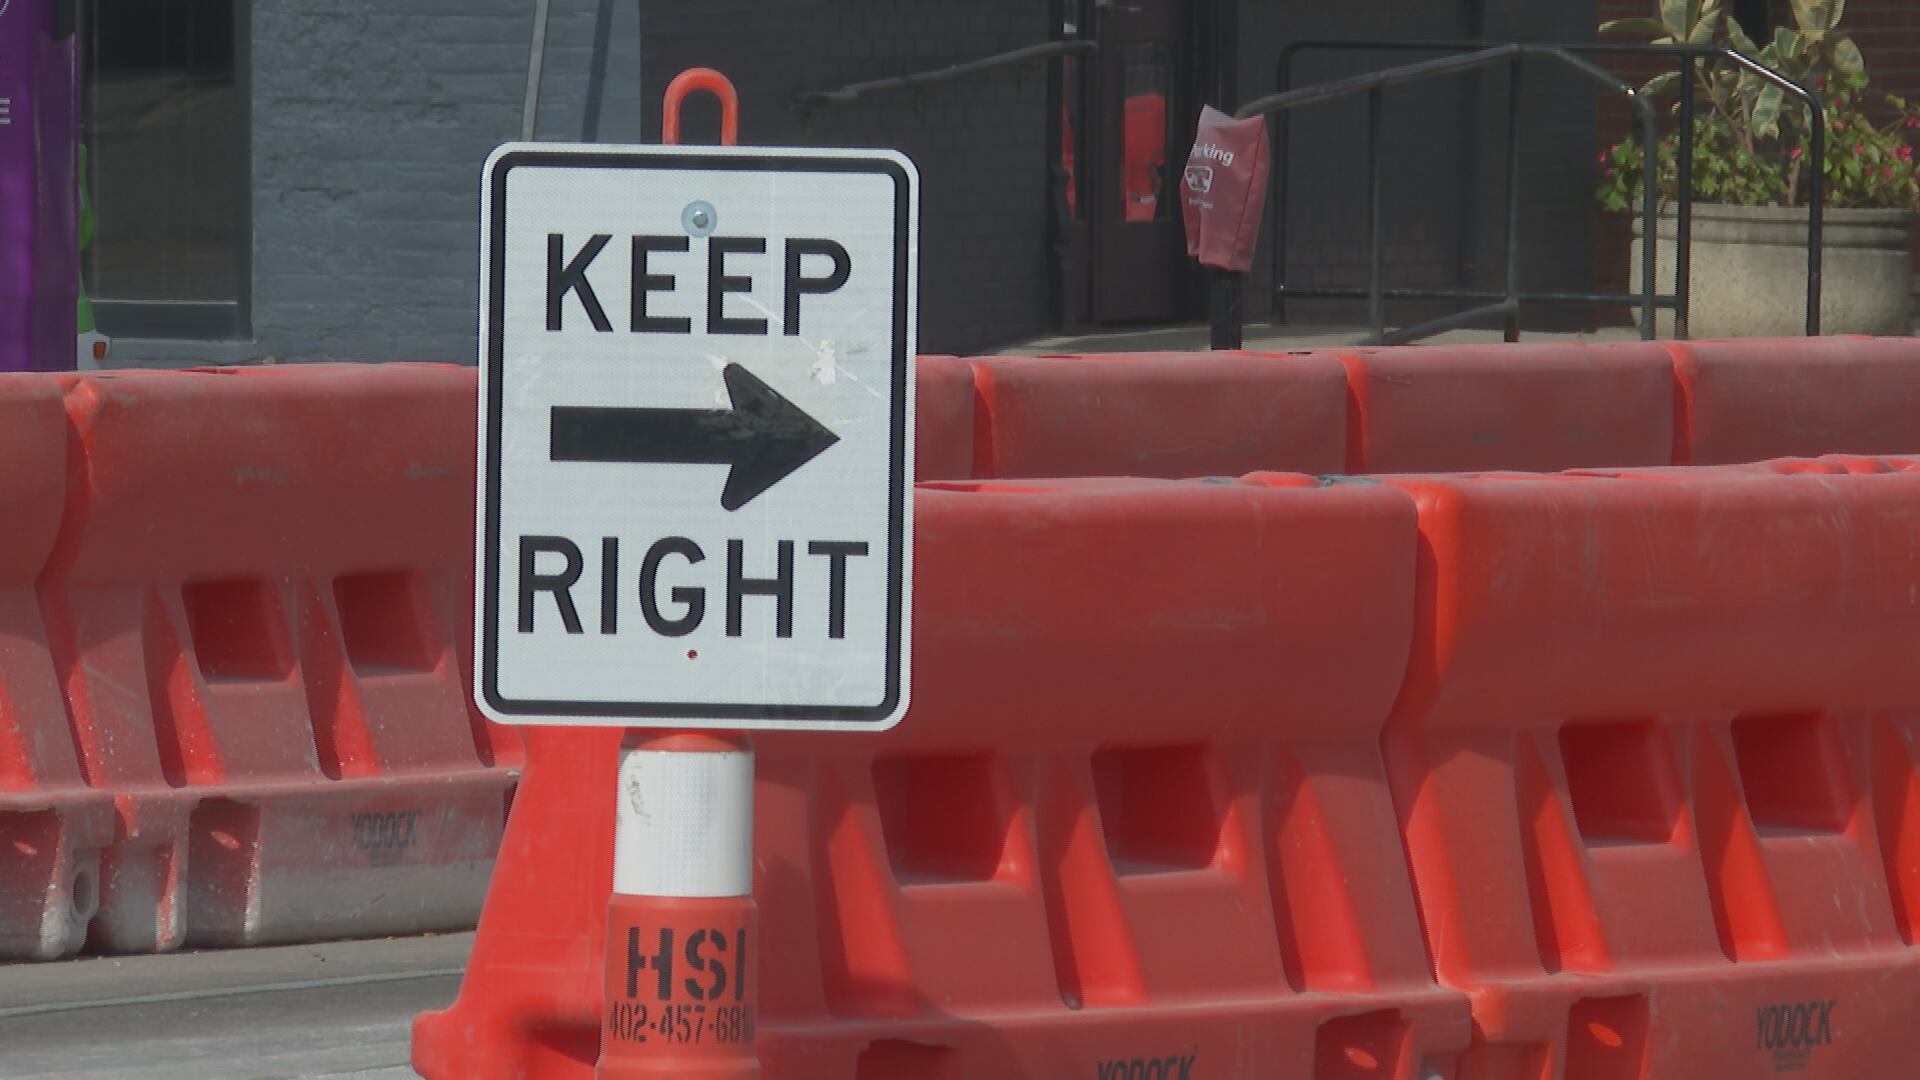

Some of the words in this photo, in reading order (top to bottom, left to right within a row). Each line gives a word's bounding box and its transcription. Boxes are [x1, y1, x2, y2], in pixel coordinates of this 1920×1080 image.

[545, 232, 852, 337] KEEP
[517, 535, 870, 640] RIGHT
[625, 926, 747, 1001] HSI
[1755, 1000, 1836, 1050] YODOCK
